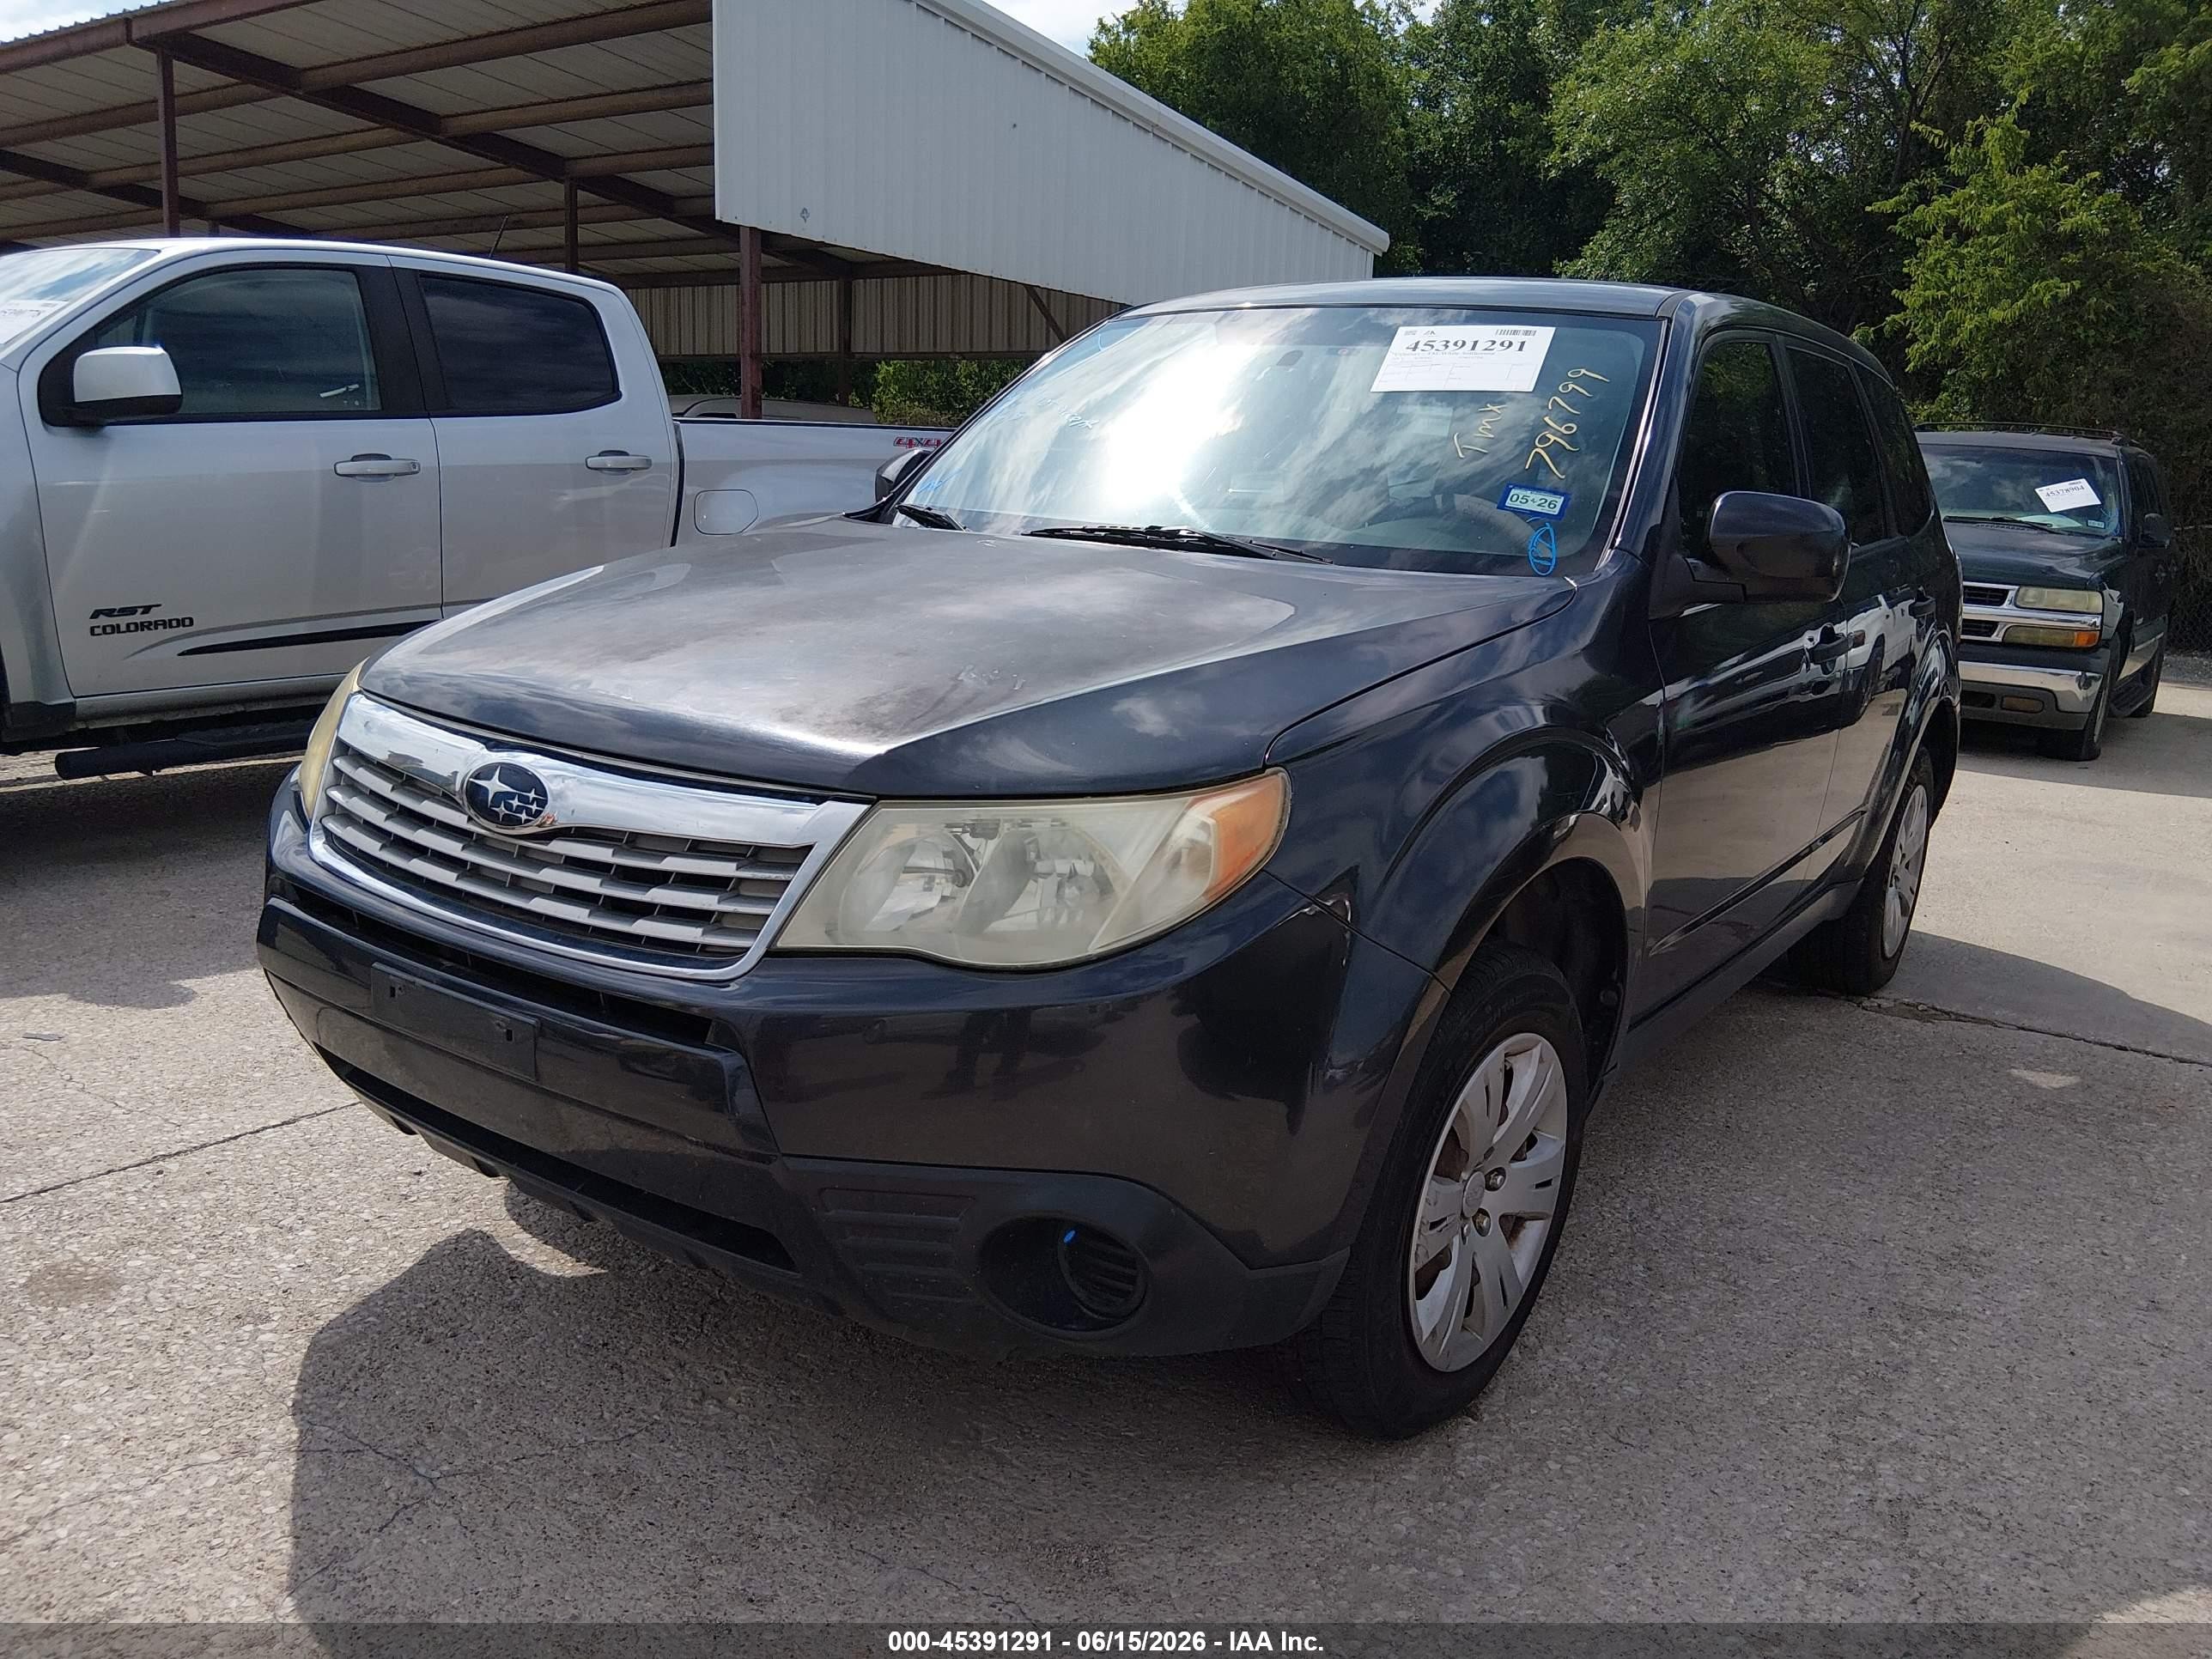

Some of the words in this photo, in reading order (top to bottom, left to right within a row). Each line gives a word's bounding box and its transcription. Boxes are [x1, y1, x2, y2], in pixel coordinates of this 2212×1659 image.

[1405, 339, 1527, 352] 45391291
[1525, 368, 1610, 478] 796799
[89, 604, 162, 619] RST
[90, 617, 194, 636] COLORADO
